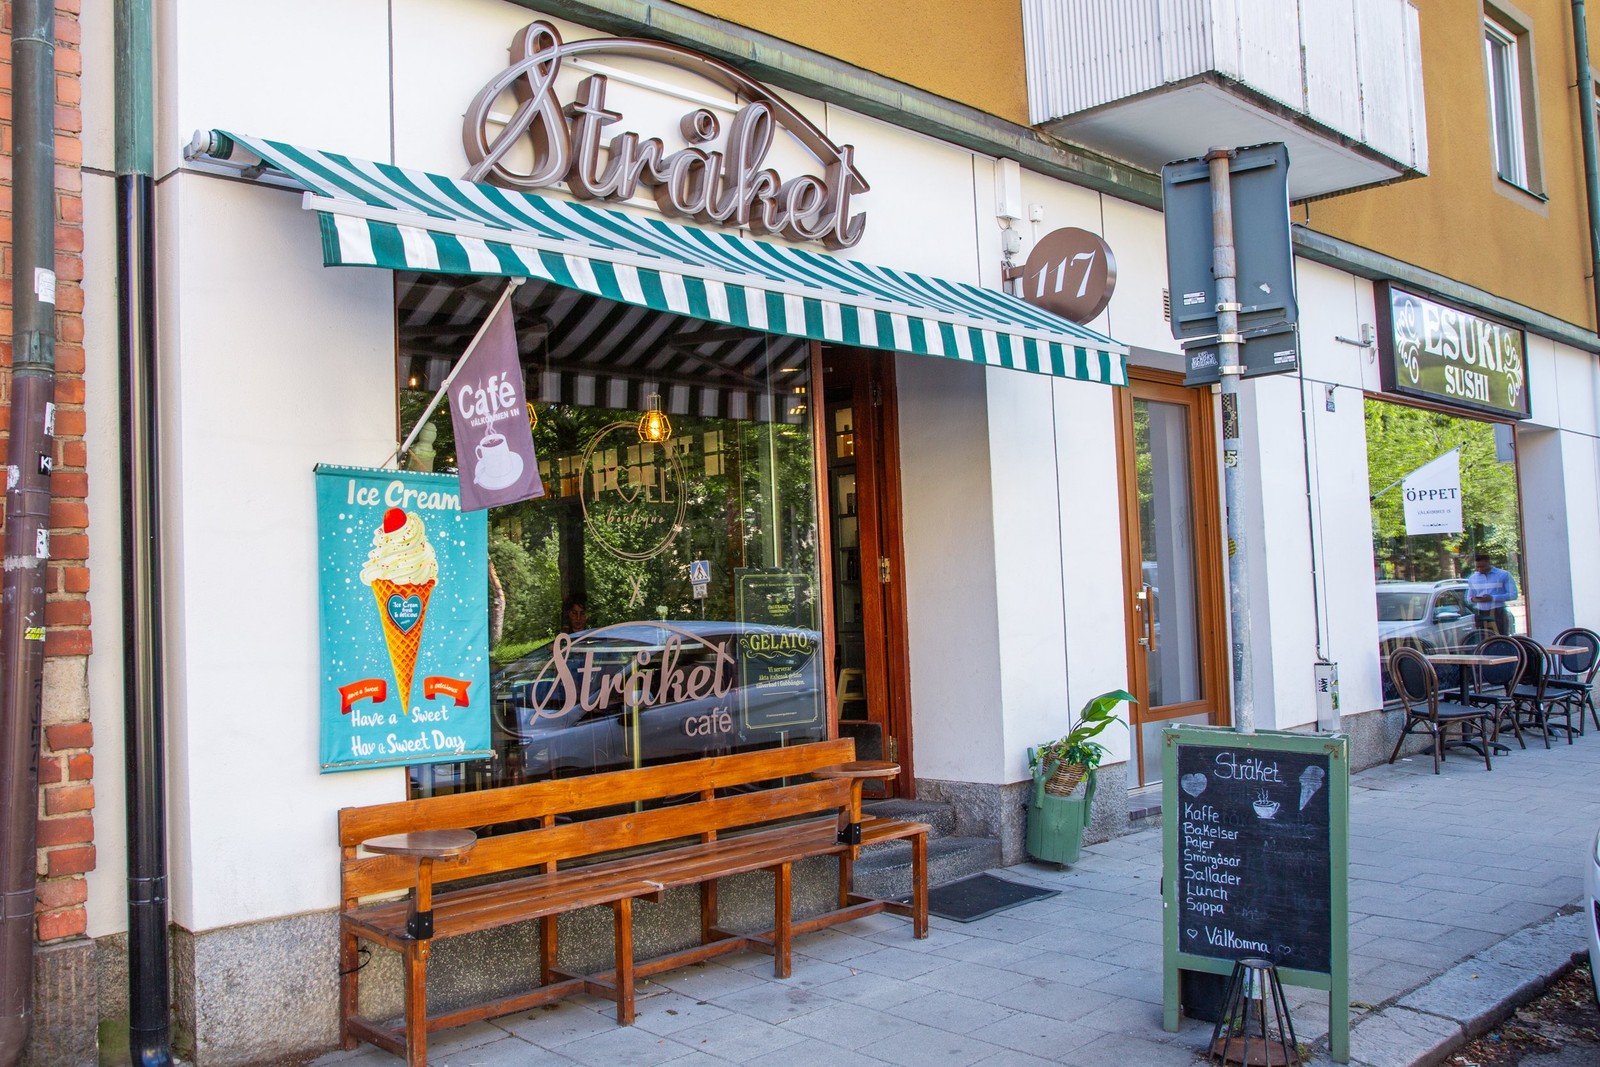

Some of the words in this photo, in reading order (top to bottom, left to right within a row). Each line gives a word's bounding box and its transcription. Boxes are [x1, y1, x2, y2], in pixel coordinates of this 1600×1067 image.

[462, 20, 870, 250] Stråket
[1031, 249, 1096, 298] 117
[1421, 301, 1504, 373] ESUKI
[1444, 365, 1490, 402] SUSHI
[458, 372, 516, 419] Café
[510, 407, 520, 417] IN
[347, 479, 380, 506] Ice
[385, 480, 461, 511] Cream
[1406, 487, 1458, 502] ÖPPET
[606, 507, 665, 529] boutique
[750, 632, 808, 651] GELATO
[530, 621, 735, 726] Stråket
[351, 709, 385, 728] Have
[388, 713, 398, 725] a
[411, 705, 449, 724] Sweet
[685, 706, 732, 737] café
[378, 742, 386, 755] a
[386, 731, 430, 754] Sweet
[431, 729, 466, 753] Day
[1184, 801, 1220, 823] Kaffe
[1185, 836, 1215, 853] Pajer
[1184, 849, 1241, 870] Smörgåsar
[1184, 863, 1242, 886] Sallader
[1186, 881, 1228, 901] Lunch
[1186, 898, 1225, 917] Soppa
